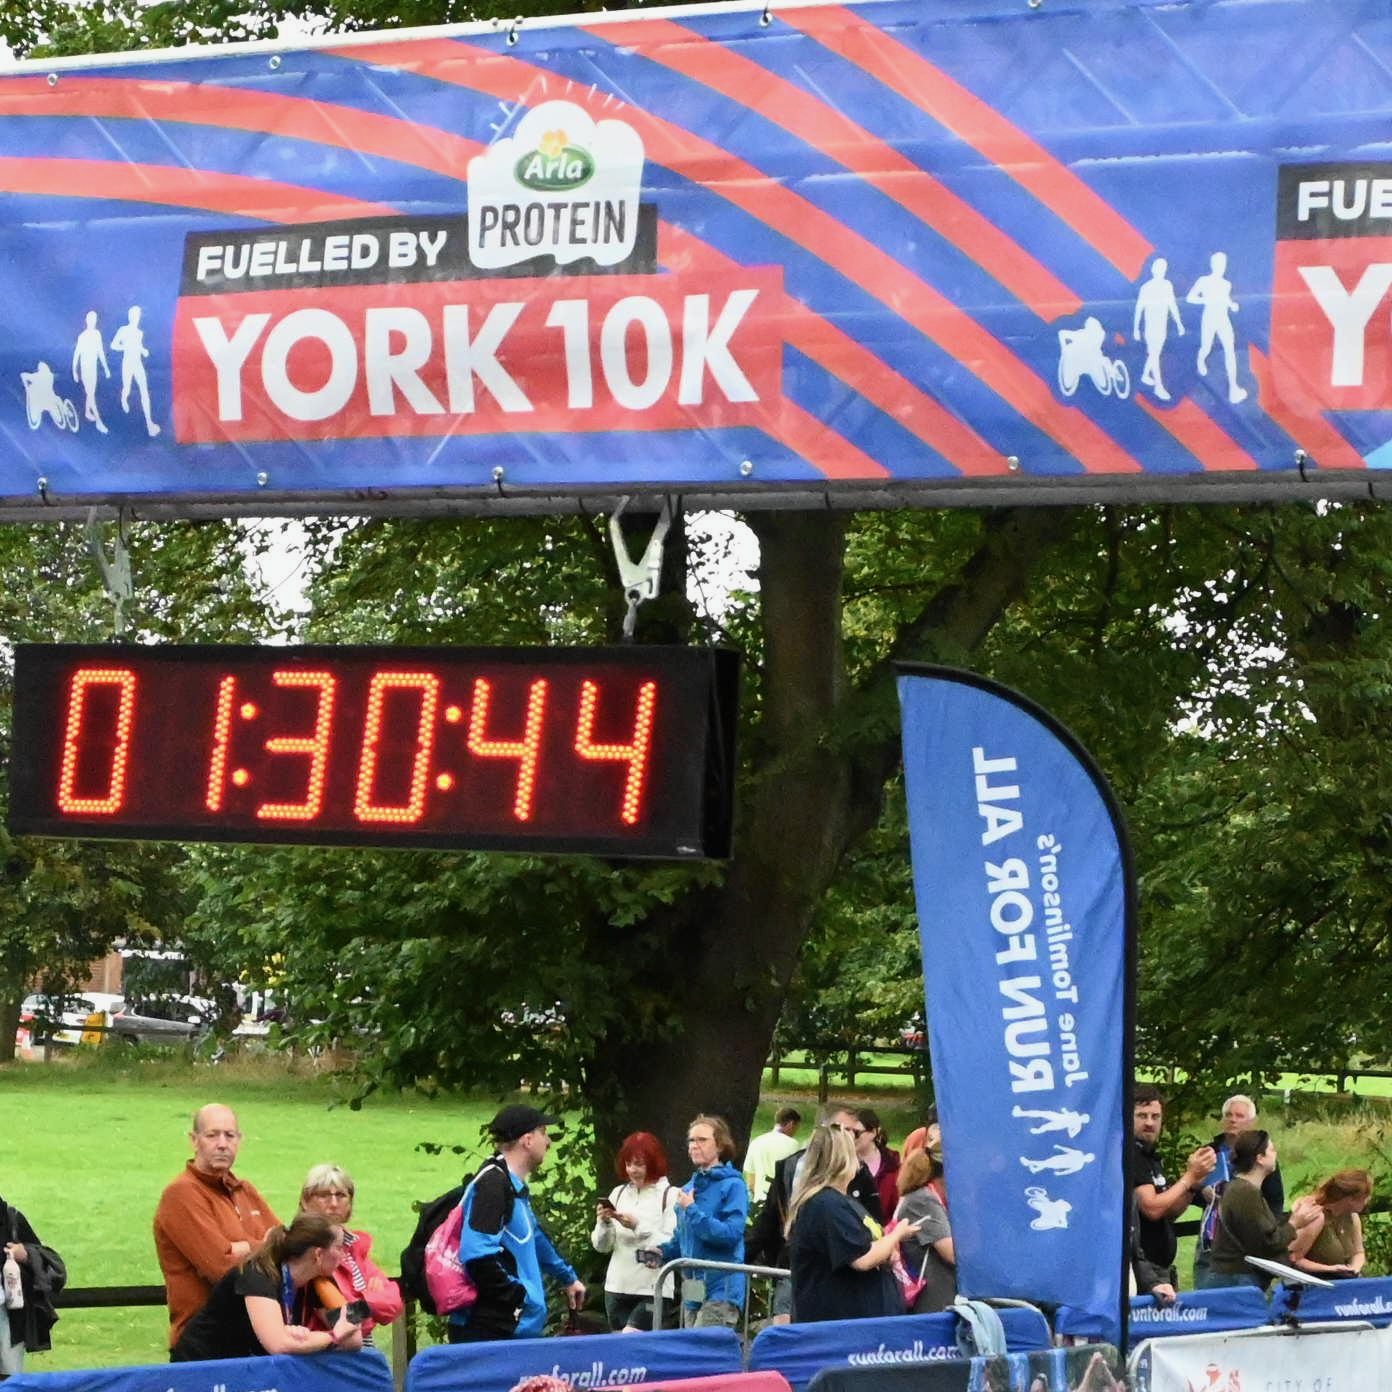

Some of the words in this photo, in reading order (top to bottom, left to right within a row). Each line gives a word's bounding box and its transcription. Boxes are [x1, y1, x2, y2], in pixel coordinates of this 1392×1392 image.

[522, 155, 583, 181] Arla
[477, 199, 625, 248] PROTEIN
[196, 234, 378, 280] FUELLED
[388, 231, 447, 267] BY
[191, 301, 533, 422] YORK
[544, 288, 760, 411] 10K
